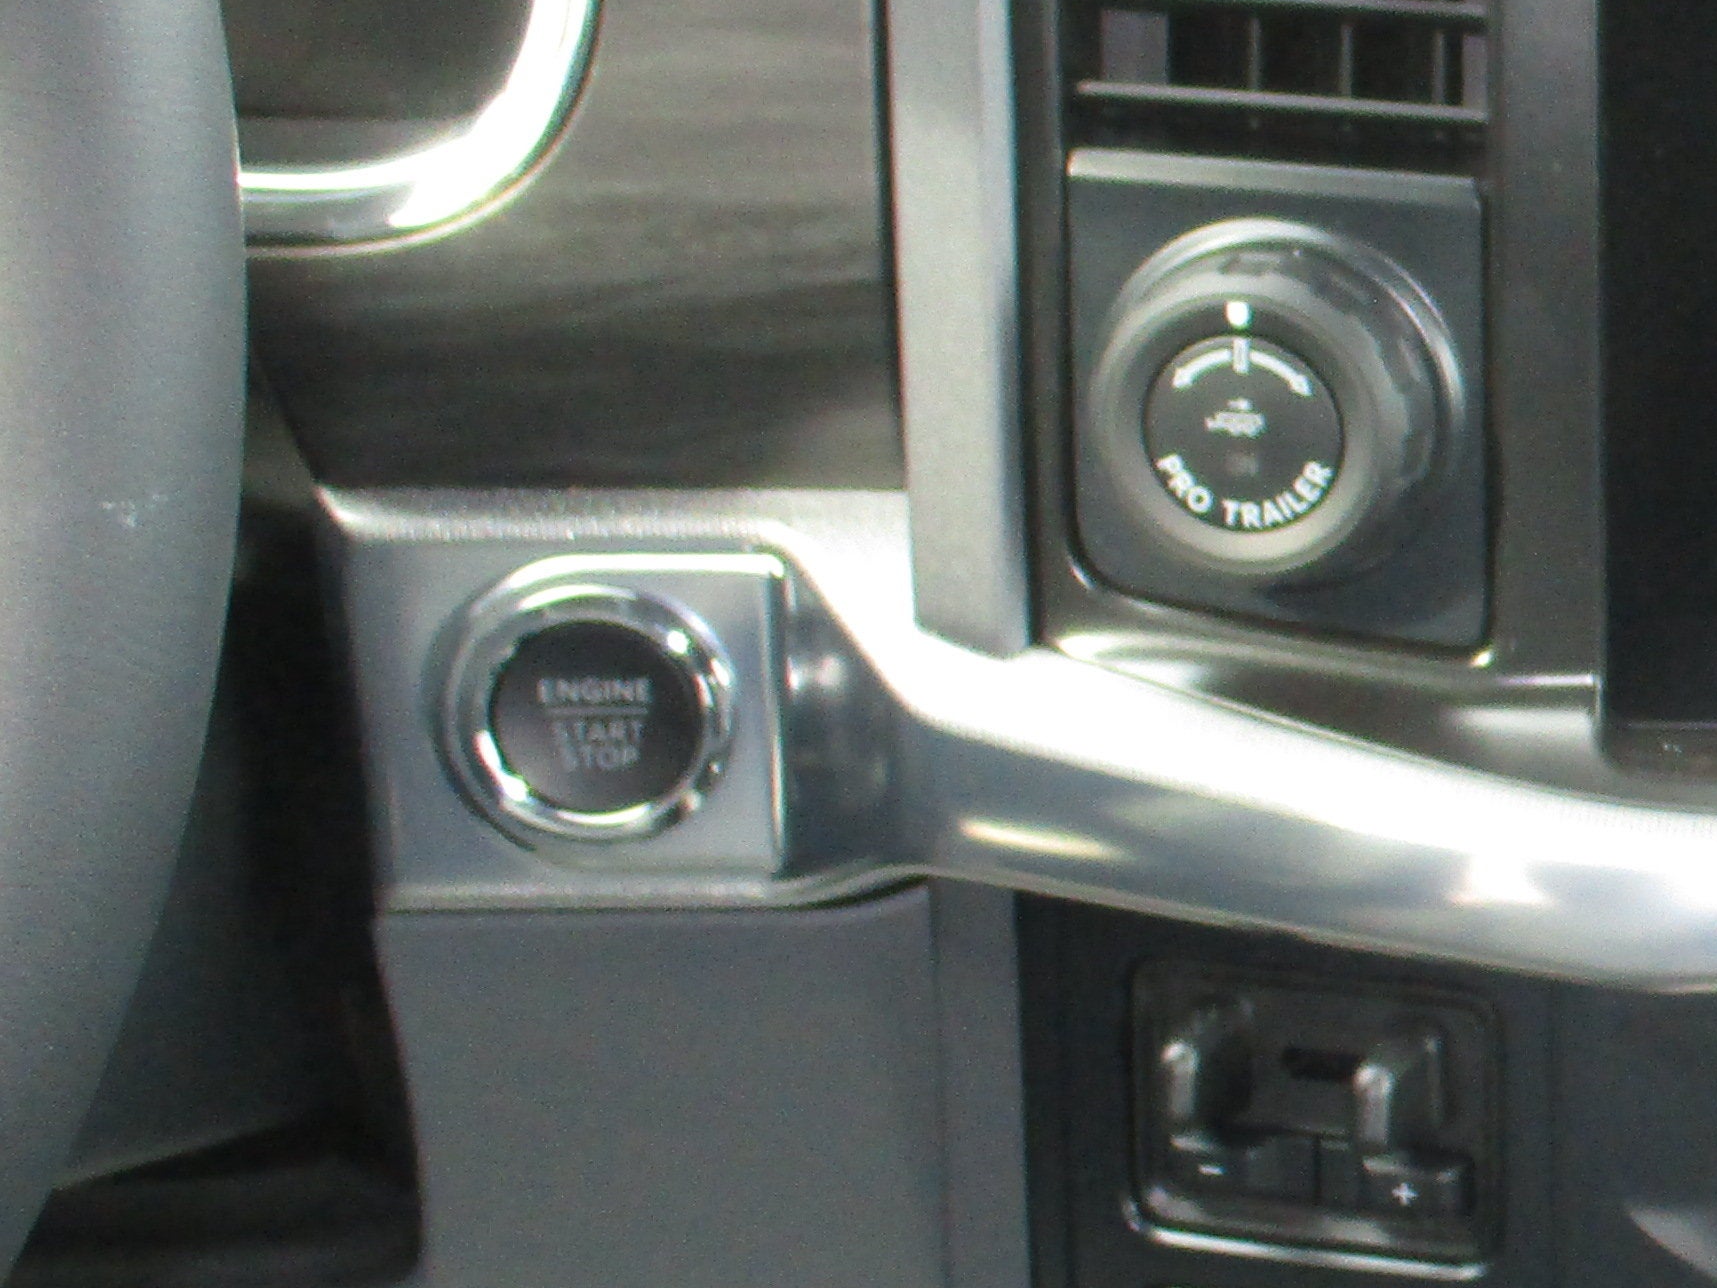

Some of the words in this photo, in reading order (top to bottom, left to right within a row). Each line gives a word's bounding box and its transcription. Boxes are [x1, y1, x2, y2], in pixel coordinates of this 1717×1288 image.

[1156, 453, 1214, 514] PRO
[1221, 460, 1334, 530] TRAILER
[536, 676, 653, 705] ENGINE
[550, 718, 646, 743] START
[560, 743, 640, 770] STOP
